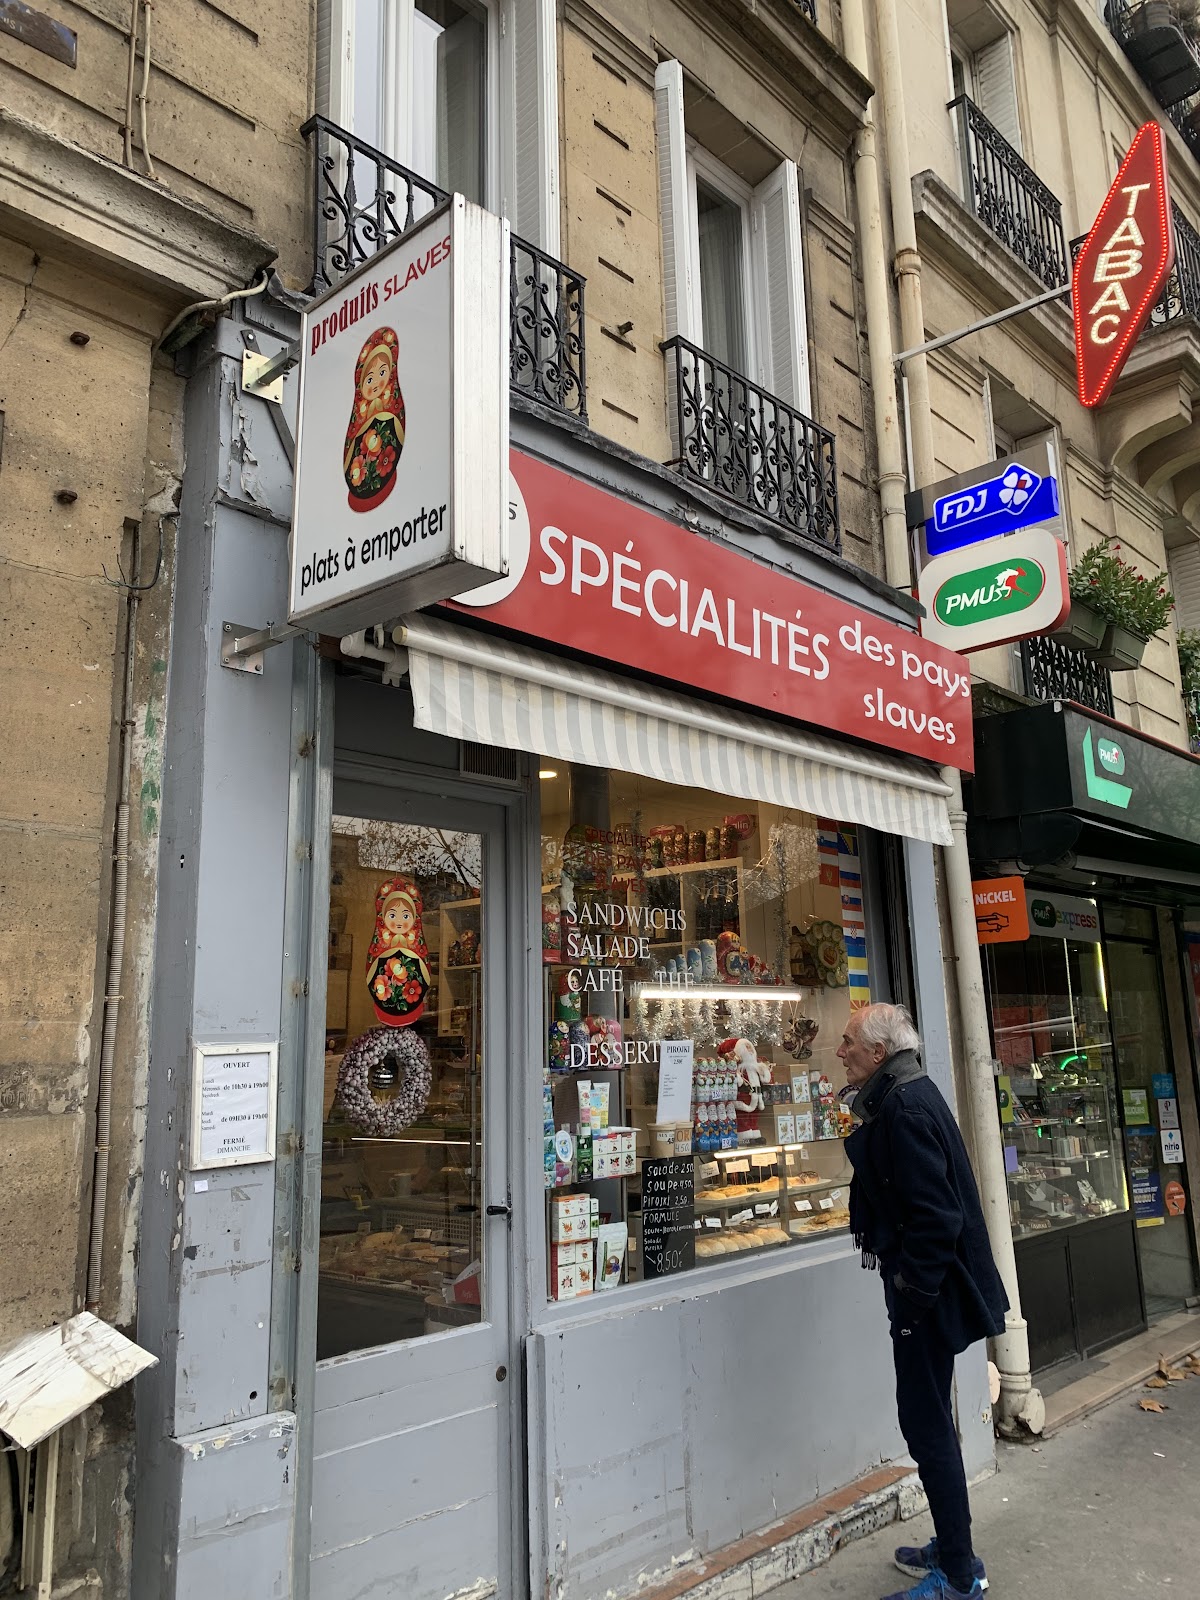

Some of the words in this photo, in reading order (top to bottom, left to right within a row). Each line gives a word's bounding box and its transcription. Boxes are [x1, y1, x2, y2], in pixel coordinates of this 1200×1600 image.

[1089, 182, 1151, 345] TABAC
[311, 281, 380, 356] produits
[383, 235, 452, 302] SLAVES
[940, 489, 988, 525] FDJ
[301, 551, 340, 595] plats
[344, 538, 356, 572] à
[361, 502, 447, 562] emporter
[540, 525, 830, 680] SPÉCIALITÉS
[839, 620, 895, 667] des
[901, 649, 970, 699] pays
[945, 585, 996, 615] PMU
[863, 688, 957, 745] slaves
[566, 901, 687, 931] SANDWICHS
[1056, 908, 1097, 931] express
[567, 933, 651, 959] SALADE
[567, 962, 624, 992] CAFÉ
[217, 1145, 251, 1154] DIMANCHE
[223, 1136, 246, 1145] FERMÉ
